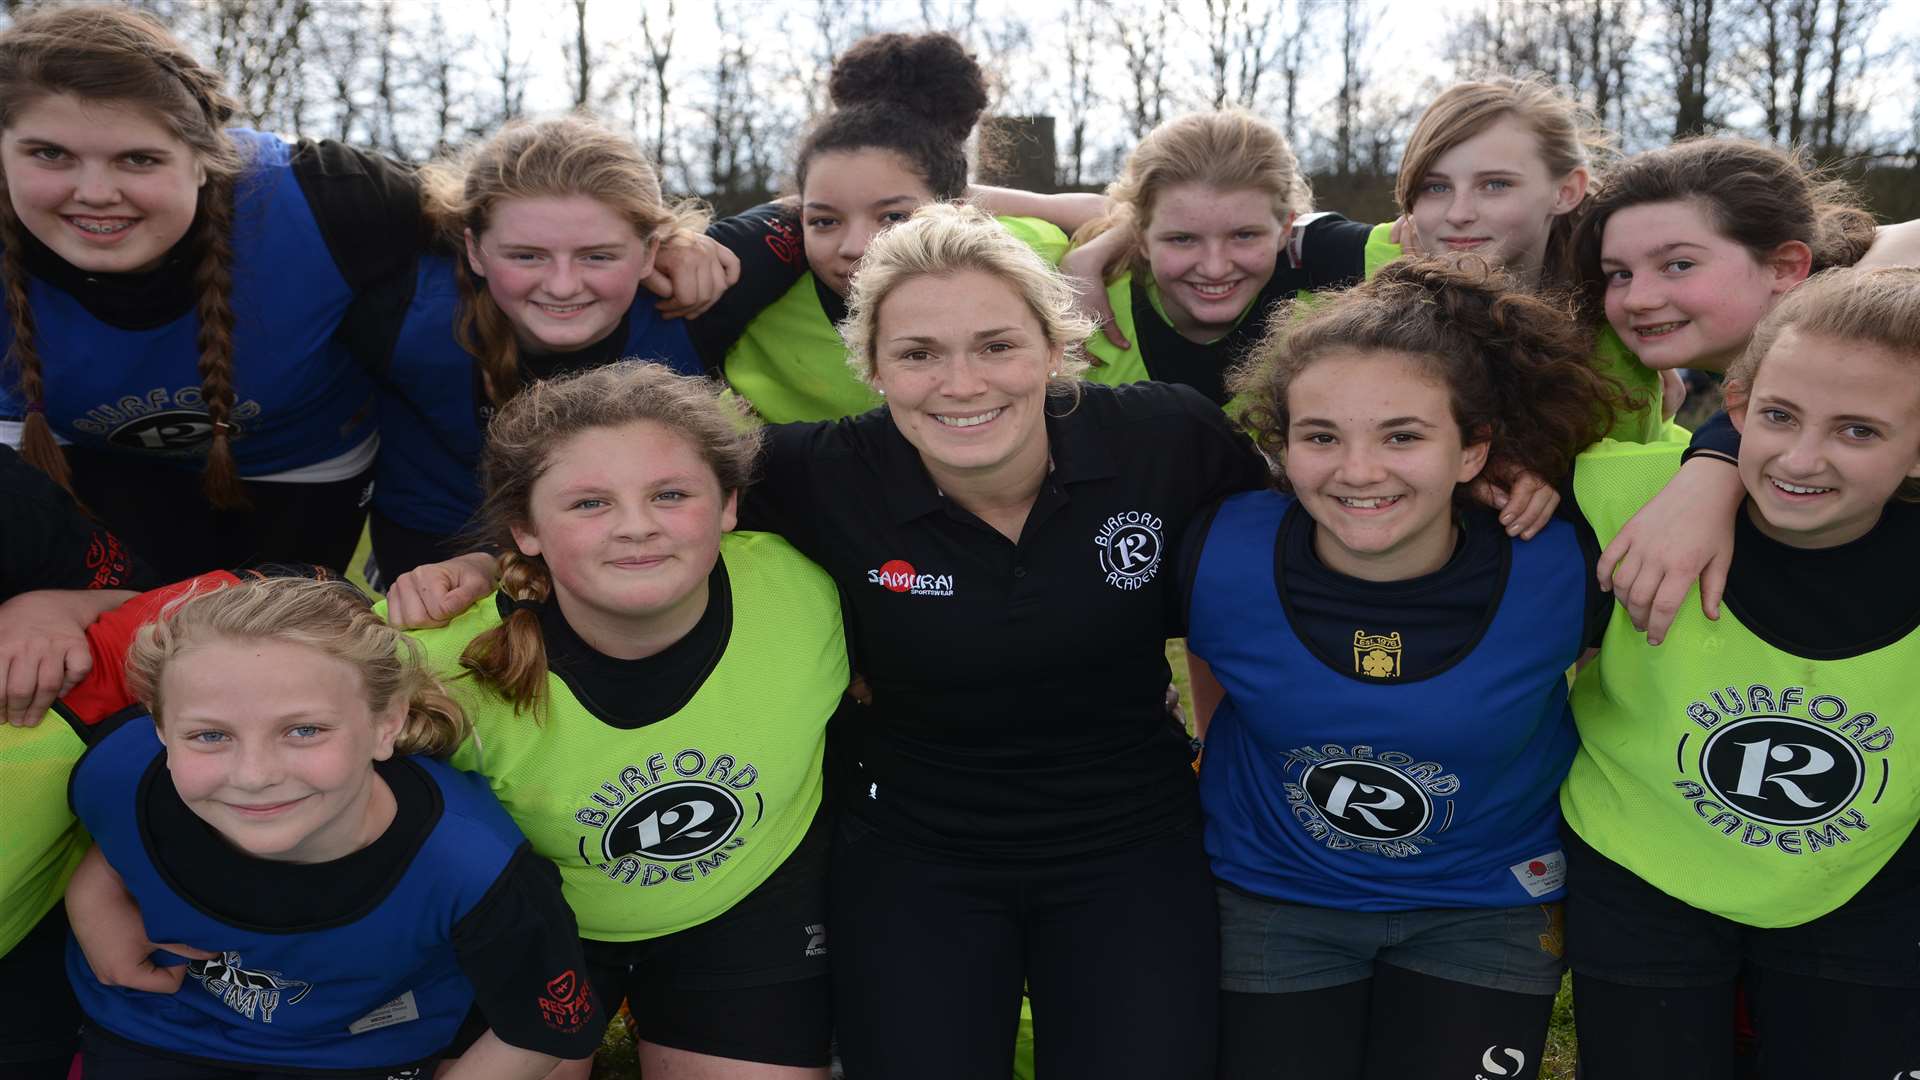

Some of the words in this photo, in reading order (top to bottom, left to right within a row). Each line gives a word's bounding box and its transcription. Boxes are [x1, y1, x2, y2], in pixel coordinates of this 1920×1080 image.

[72, 386, 262, 434] BURFOD
[1095, 511, 1162, 547] BURFORD
[1114, 533, 1152, 570] 12
[867, 569, 953, 590] SAMURAI
[1686, 684, 1895, 753] BURFORD
[575, 749, 759, 829] BURFORD
[1726, 737, 1836, 808] 12
[626, 800, 715, 850] 12
[1319, 775, 1407, 832] 12
[1672, 779, 1871, 855] ACADEMY
